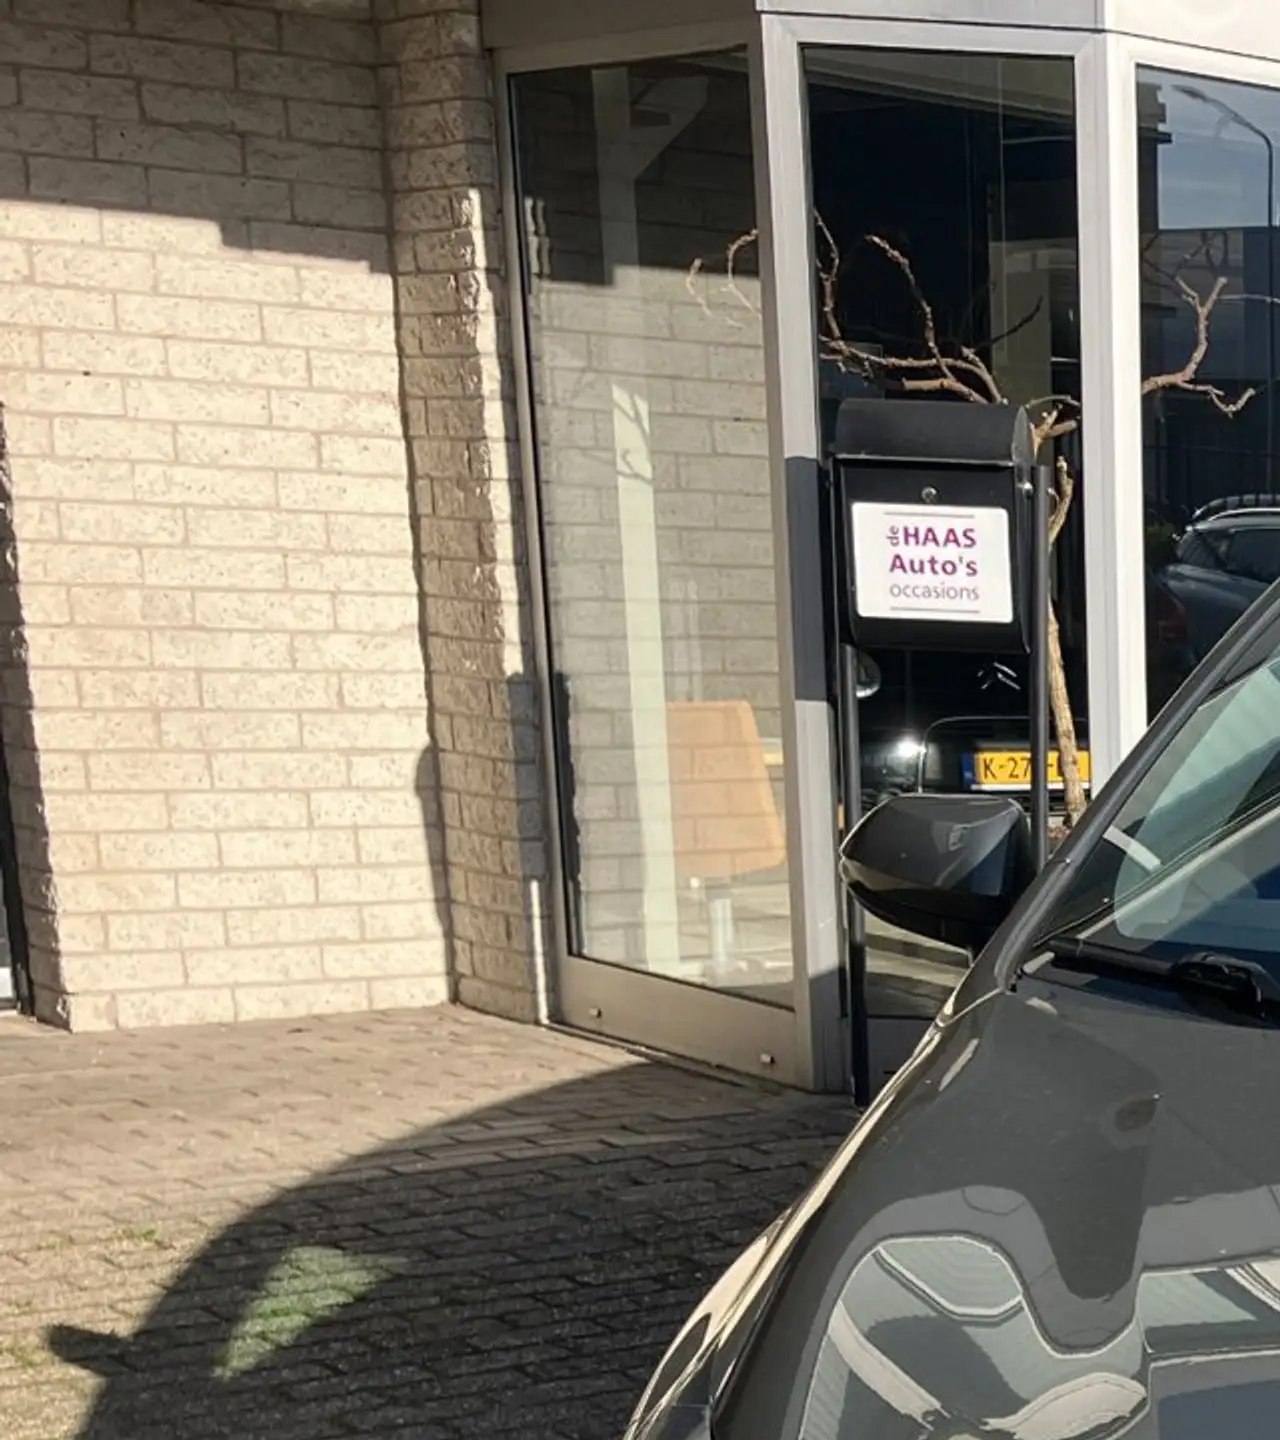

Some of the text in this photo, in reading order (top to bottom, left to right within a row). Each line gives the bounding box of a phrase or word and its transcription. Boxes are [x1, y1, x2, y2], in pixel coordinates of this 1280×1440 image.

[887, 525, 976, 548] de HAAS
[889, 553, 978, 577] Auto's
[889, 582, 980, 601] occasions
